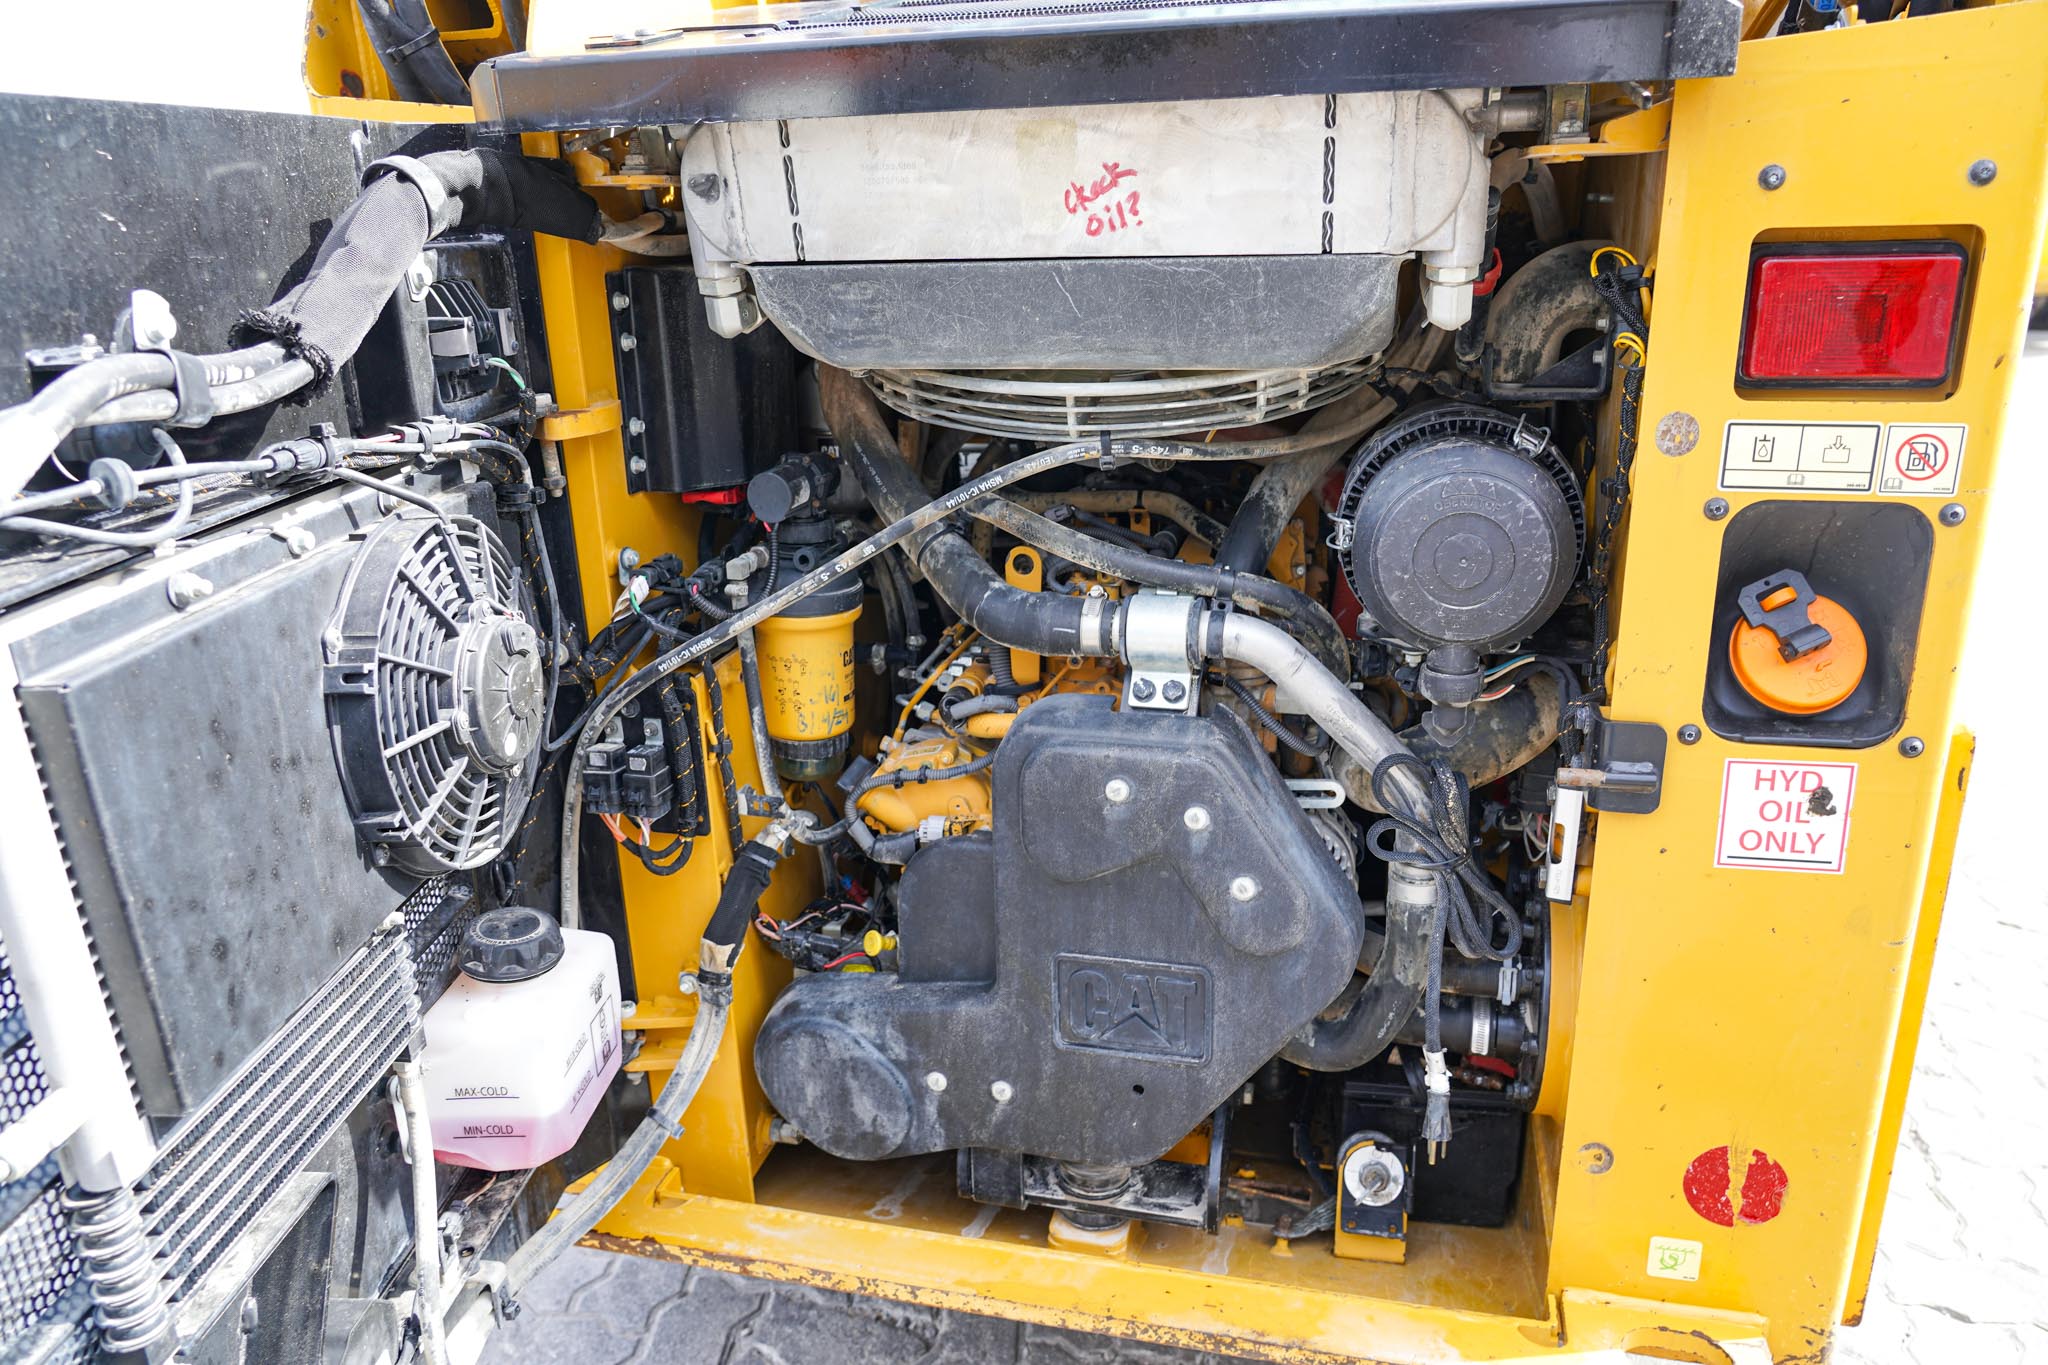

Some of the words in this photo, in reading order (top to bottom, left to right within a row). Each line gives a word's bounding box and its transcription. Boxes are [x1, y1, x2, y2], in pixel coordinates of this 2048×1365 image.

[979, 475, 1004, 493] MSHA
[692, 637, 714, 657] MSHA
[843, 647, 855, 667] CA
[1754, 769, 1823, 793] HYD
[1759, 800, 1811, 824] OIL
[1739, 829, 1825, 855] ONLY
[1069, 968, 1198, 1053] CAT
[454, 1086, 509, 1097] MAX-COLD
[463, 1125, 514, 1136] MIN-COLD
